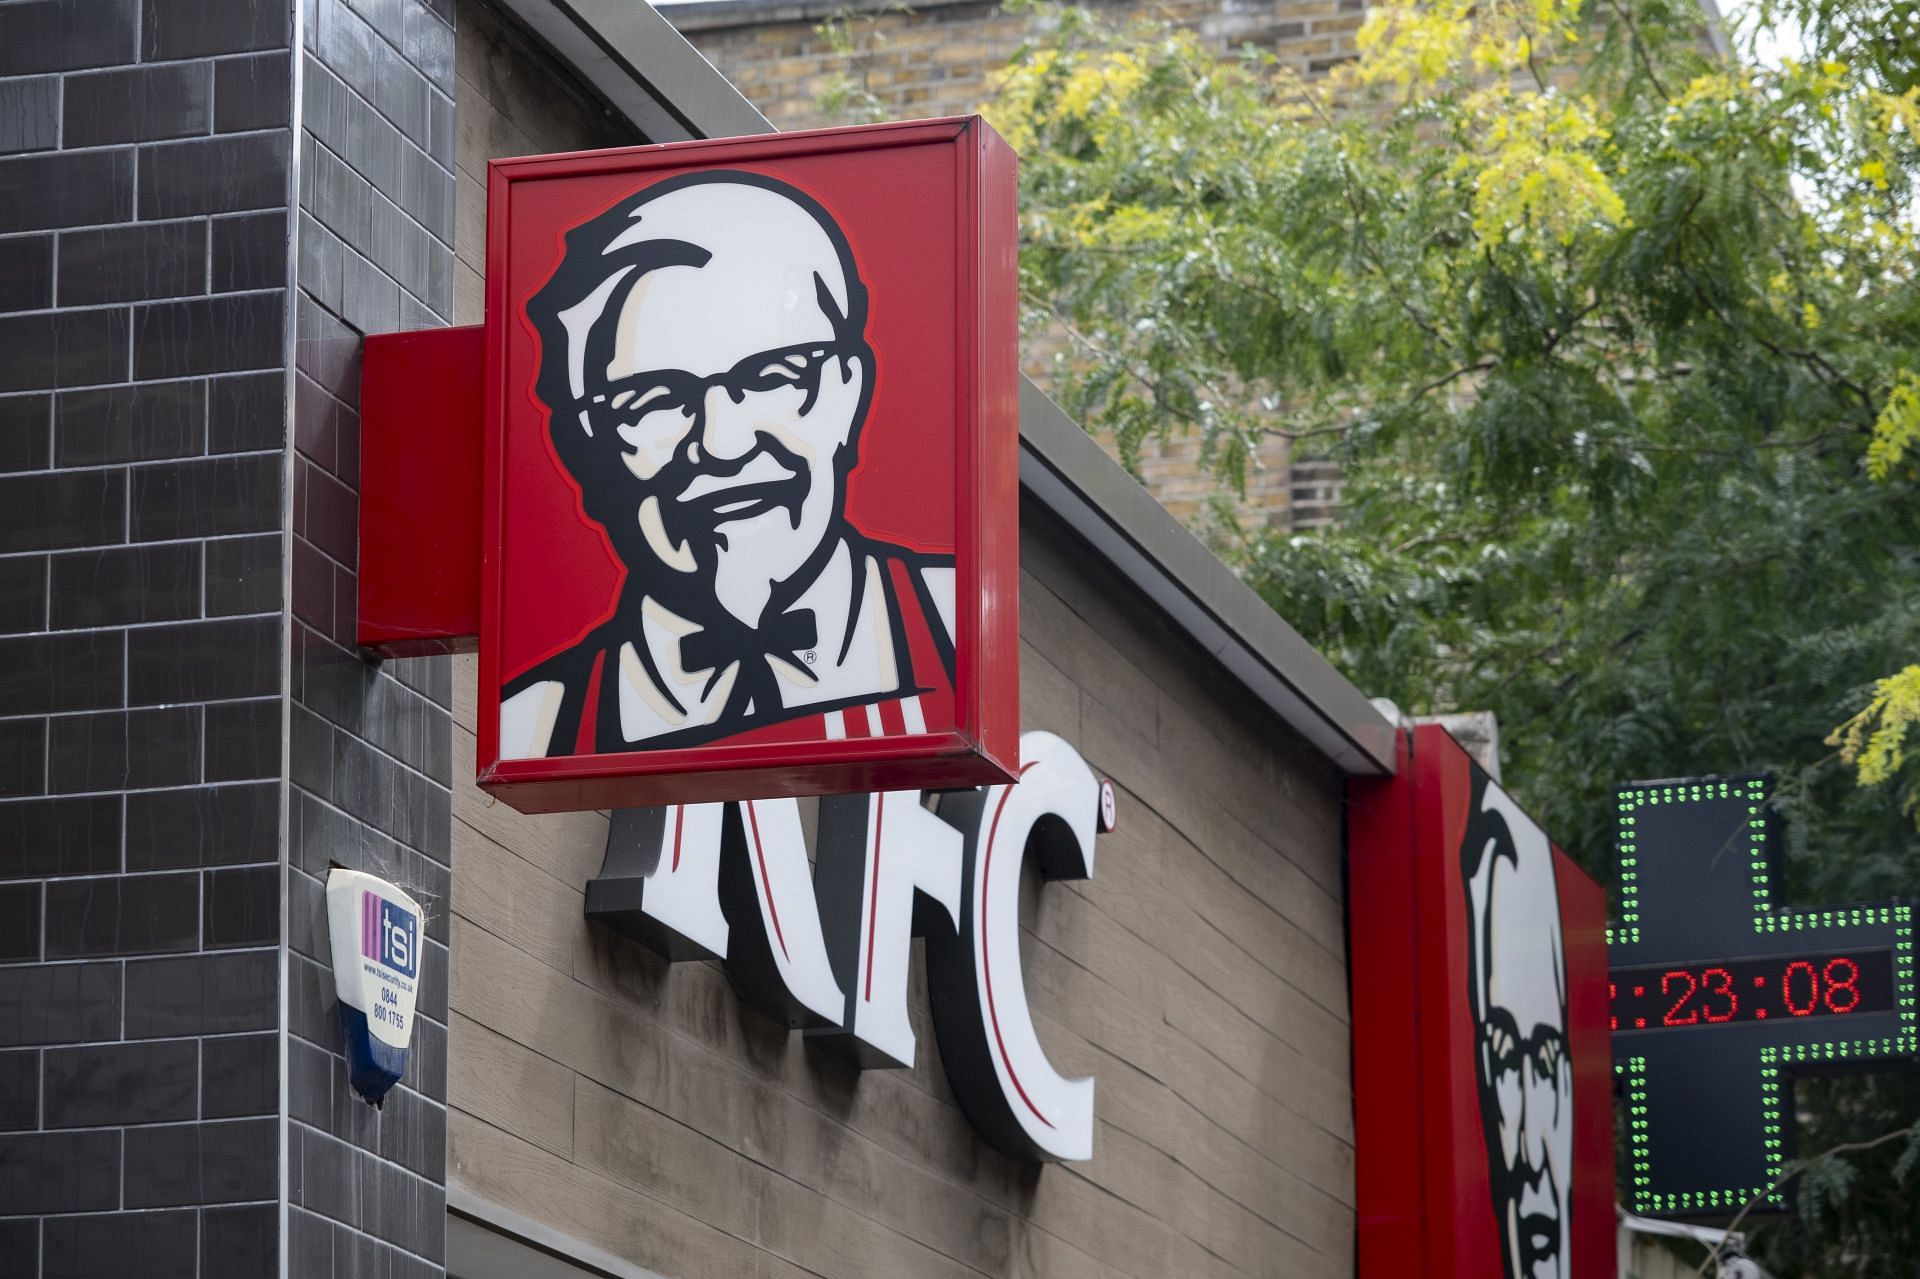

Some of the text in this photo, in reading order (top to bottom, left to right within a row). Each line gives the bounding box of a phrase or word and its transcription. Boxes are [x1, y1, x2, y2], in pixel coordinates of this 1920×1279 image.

[383, 909, 414, 972] tsi
[363, 962, 414, 993] www.tsisecurity.co.uk
[381, 987, 398, 1006] 0844
[1608, 957, 1861, 1031] :23:08
[374, 1003, 404, 1030] 800 1755
